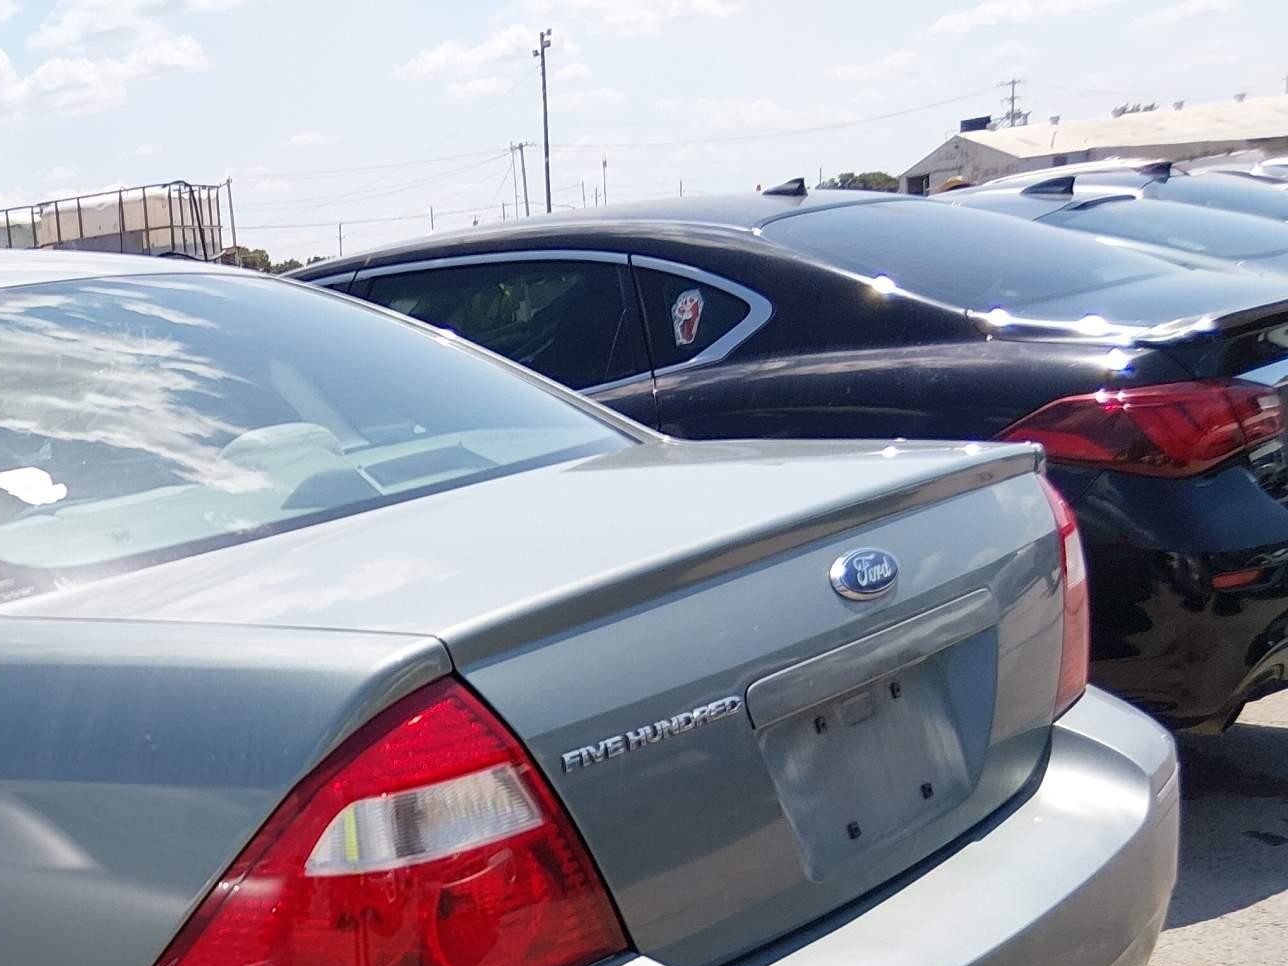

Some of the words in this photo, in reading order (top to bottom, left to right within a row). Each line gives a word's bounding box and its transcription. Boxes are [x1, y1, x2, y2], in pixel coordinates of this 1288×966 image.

[853, 554, 892, 587] Ford
[562, 735, 625, 773] FIVE
[625, 695, 743, 750] HUNDRED
